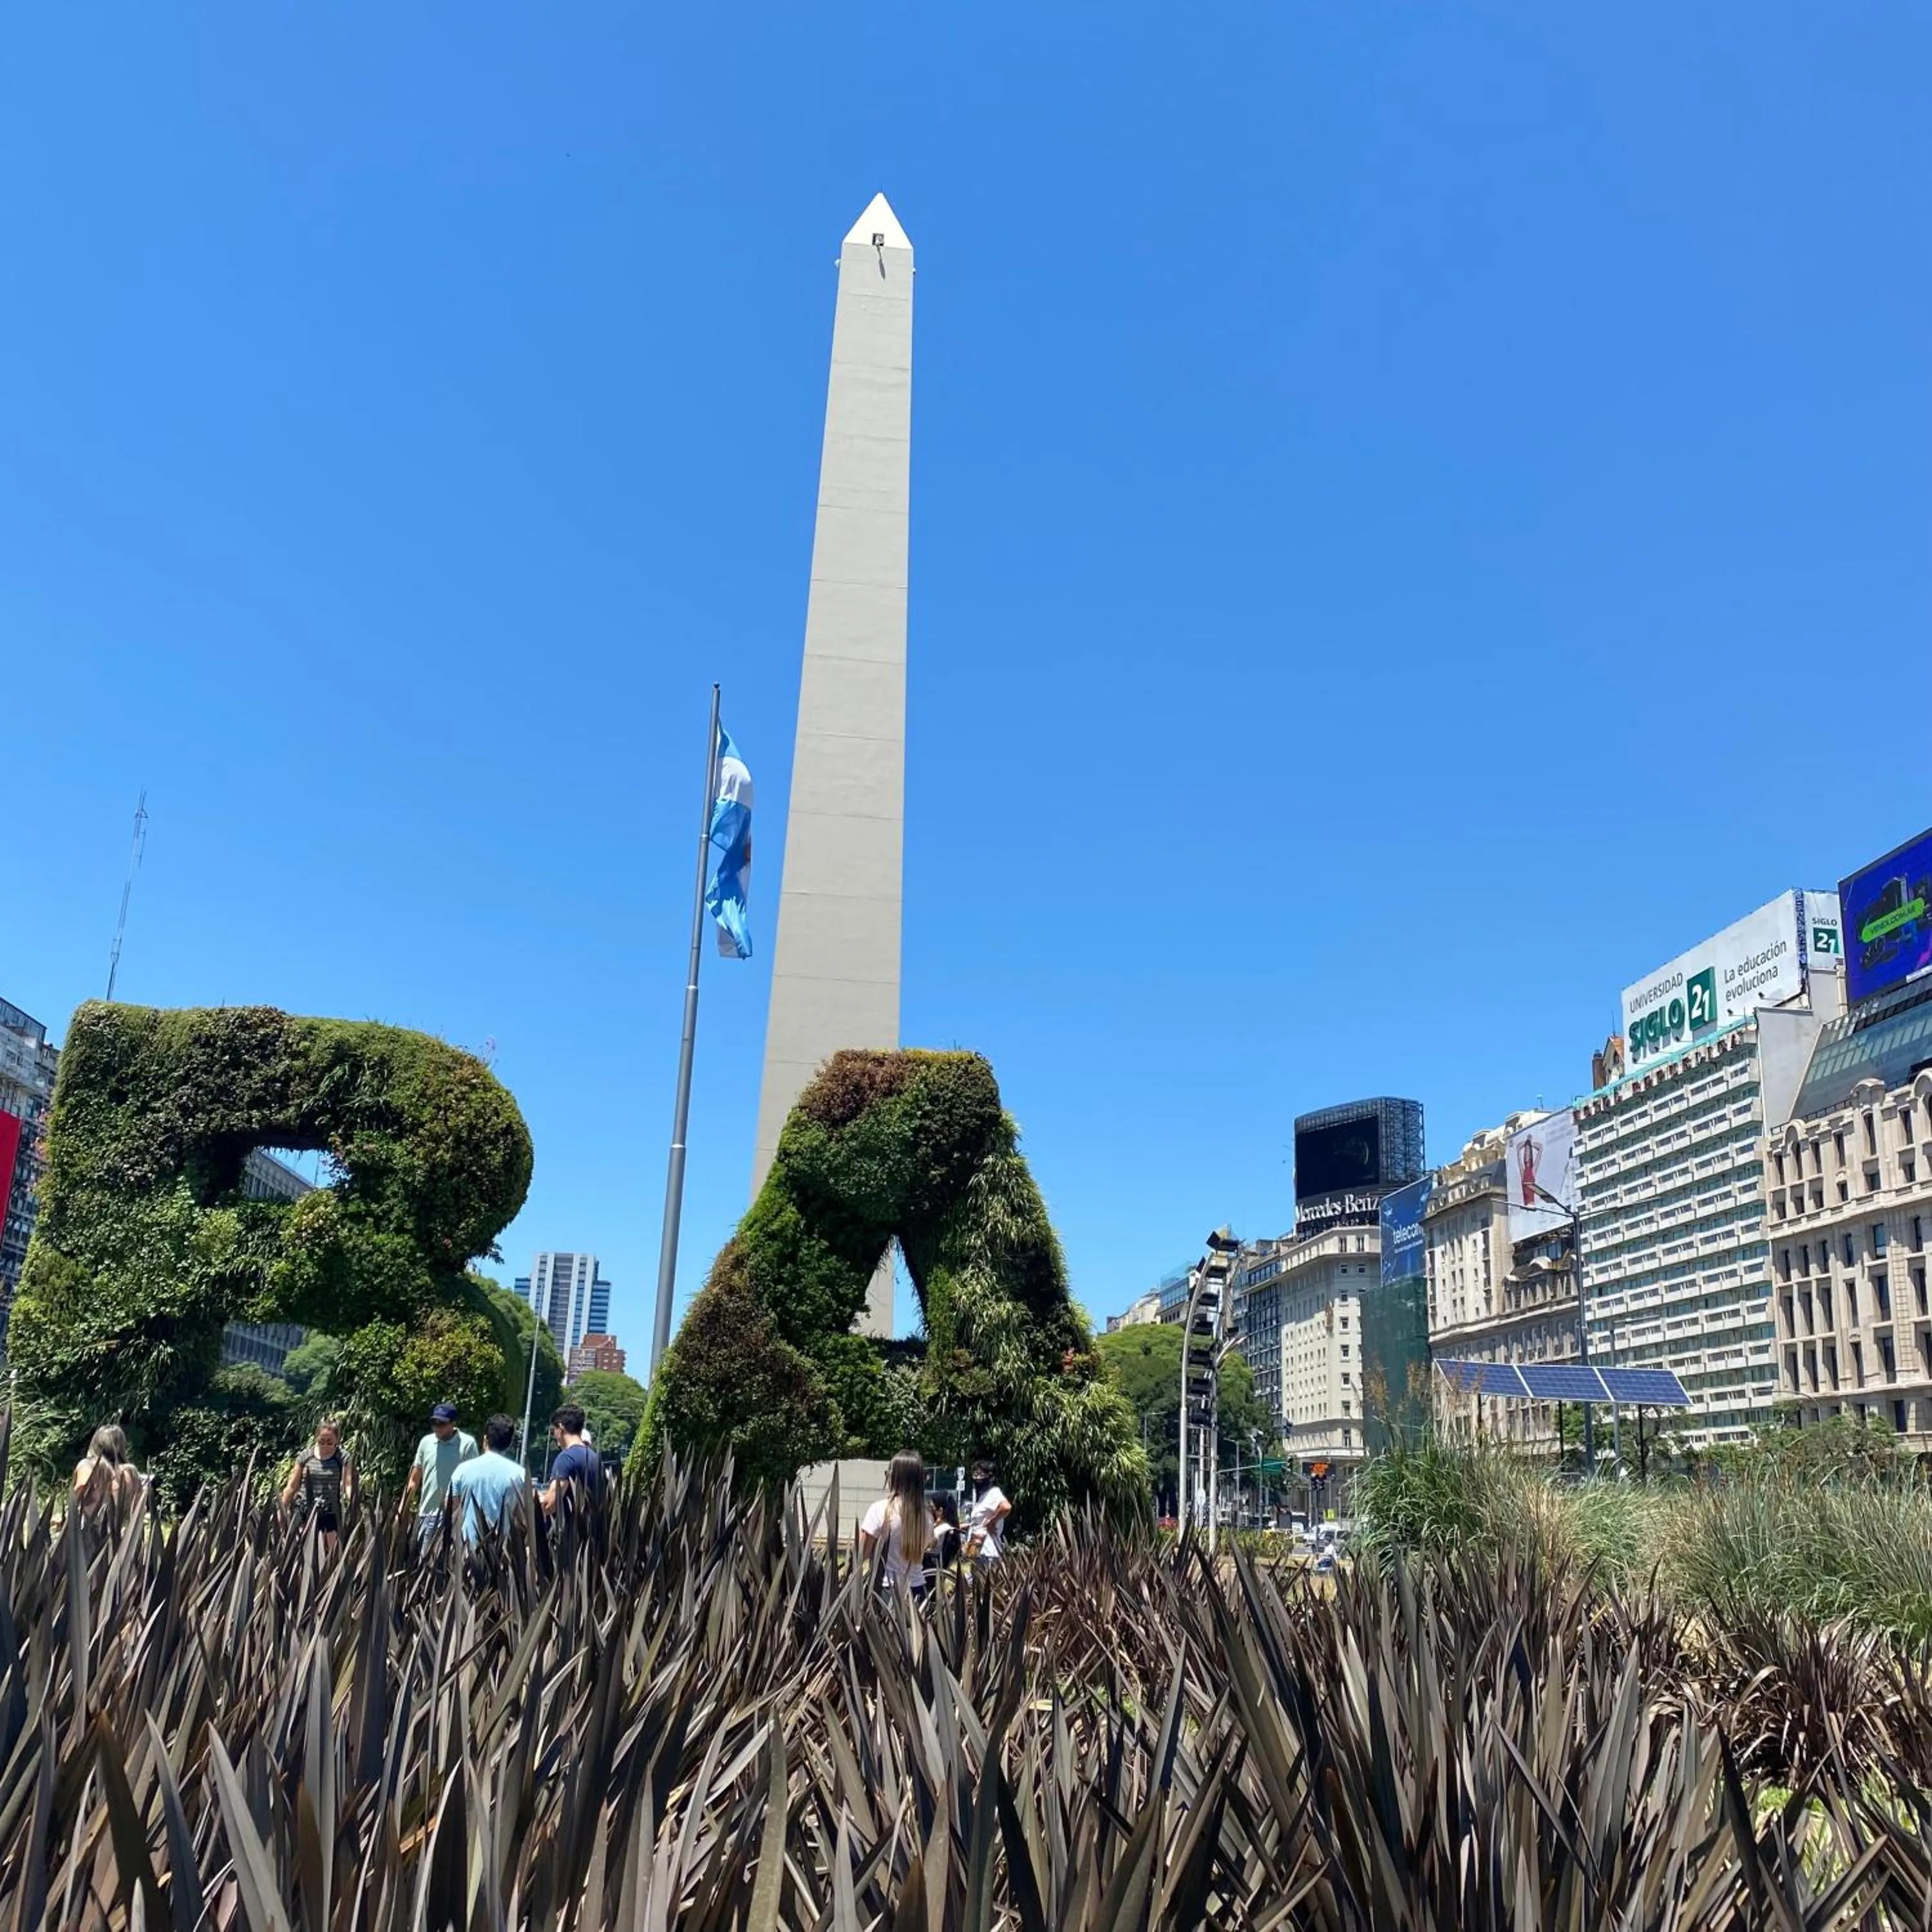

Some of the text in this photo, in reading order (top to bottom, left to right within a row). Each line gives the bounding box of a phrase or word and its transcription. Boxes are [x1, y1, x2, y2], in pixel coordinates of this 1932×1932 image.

[1812, 917, 1837, 926] SIGLO
[1817, 932, 1837, 954] 21
[1723, 940, 1788, 984] La educación
[1629, 972, 1683, 1013] UNIVERSIDAD
[1725, 965, 1779, 1002] evoluciona
[1629, 983, 1711, 1054] SIGLO 21
[1294, 1193, 1380, 1224] Mercedes-Benz
